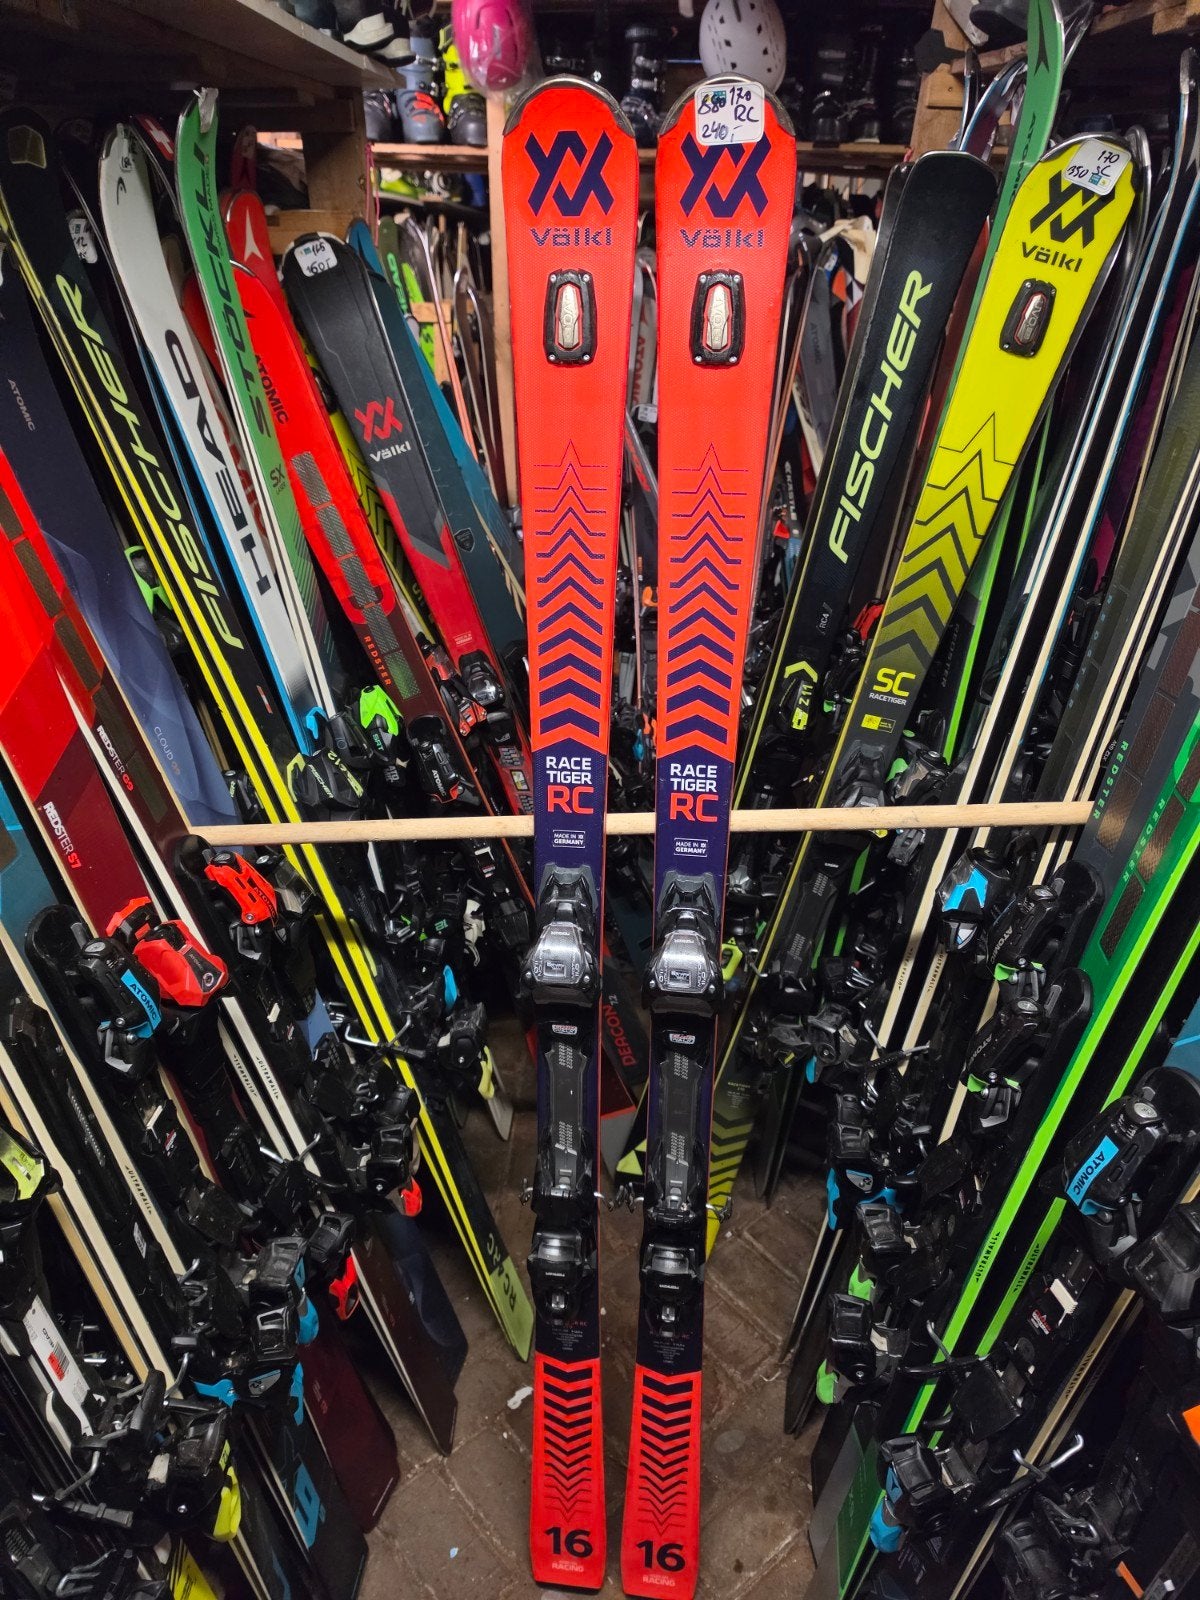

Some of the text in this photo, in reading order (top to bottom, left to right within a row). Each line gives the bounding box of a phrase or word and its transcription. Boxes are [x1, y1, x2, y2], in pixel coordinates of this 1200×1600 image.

[729, 85, 752, 105] 170
[734, 104, 759, 123] RC
[1097, 150, 1120, 164] 170
[531, 227, 612, 247] Völkl
[679, 228, 764, 248] Völkl
[1022, 241, 1083, 273] Völkl
[194, 142, 272, 438] STÖCKLI
[8, 378, 37, 431] ATOMIC
[829, 270, 933, 565] FISCHER
[55, 273, 245, 650] FISCHER
[165, 329, 271, 596] HEAD
[368, 440, 412, 462] Völkl
[269, 462, 286, 487] SX
[364, 635, 392, 686] REDSTER
[873, 667, 916, 697] SC
[868, 692, 907, 706] RACETIGER
[96, 725, 127, 775] REDSTER
[153, 726, 174, 761] CLOUD
[546, 756, 592, 770] RACE
[546, 770, 592, 785] TIGER
[670, 763, 718, 778] RACE
[308, 764, 335, 798] FISCHER
[431, 769, 447, 797] ATOMIC
[670, 777, 718, 792] TIGER
[1092, 740, 1129, 820] REDSTER
[547, 785, 594, 814] RC
[669, 792, 719, 822] RC
[43, 801, 74, 855] REDSTER
[554, 839, 584, 847] GERMANY
[1121, 797, 1166, 881] REDSTER
[675, 846, 706, 855] GERMANY
[991, 926, 1013, 963] ATOMIC
[128, 982, 160, 1020] ATOMIC
[603, 1004, 637, 1066] DEACON
[1074, 1150, 1106, 1197] ATOMIC
[128, 1170, 152, 1211] ULTRAWALL
[975, 1235, 1000, 1278] ULTRAWALL
[1015, 1246, 1042, 1290] ULTRAWALL
[543, 1526, 593, 1558] 16
[636, 1540, 686, 1573] 16
[551, 1562, 584, 1573] RACING
[642, 1574, 676, 1587] RACING
